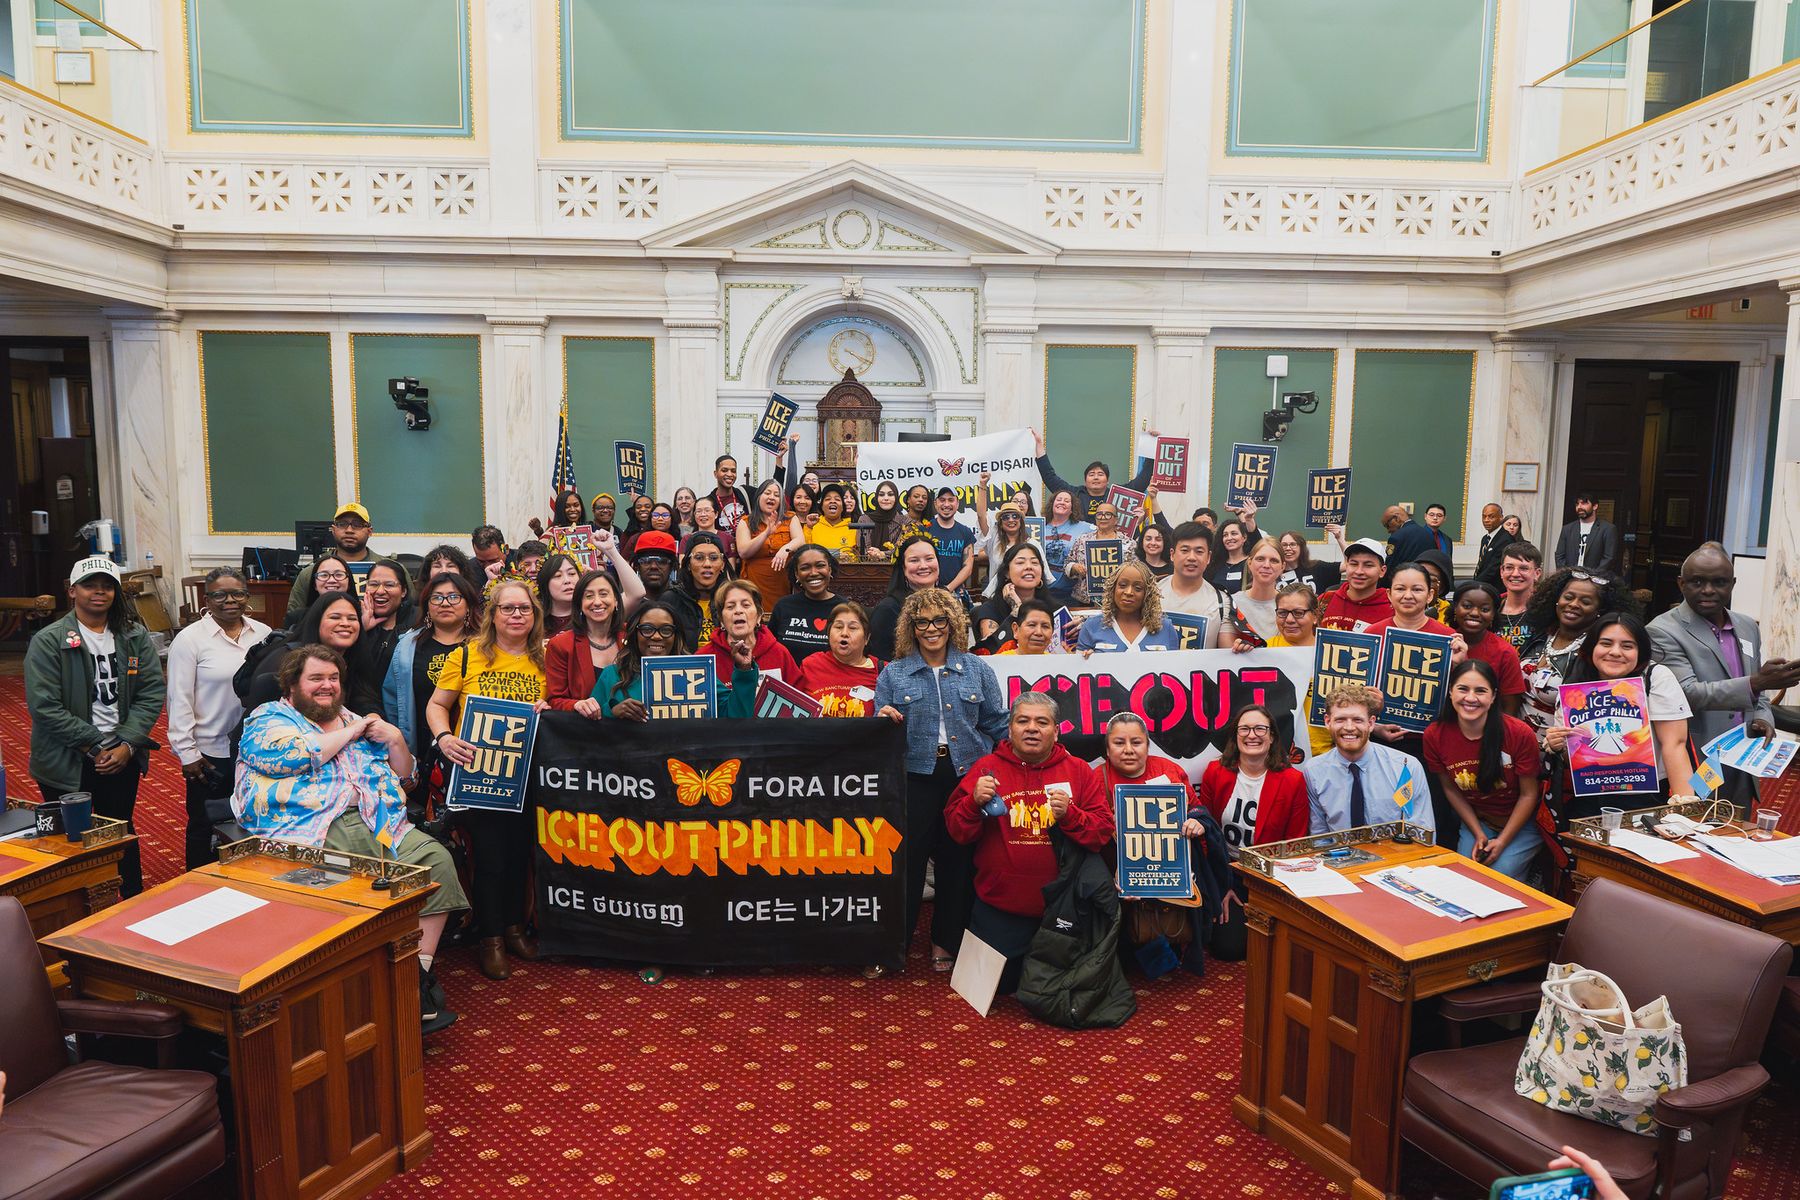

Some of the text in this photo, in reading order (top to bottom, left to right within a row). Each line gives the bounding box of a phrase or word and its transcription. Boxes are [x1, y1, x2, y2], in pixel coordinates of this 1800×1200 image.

[769, 400, 793, 424] ICE
[763, 416, 787, 438] OUT
[620, 447, 643, 465] ICE
[1160, 443, 1184, 461] ICE
[967, 456, 1033, 474] ICE DIŞARI
[1157, 461, 1183, 477] OUT
[1237, 452, 1271, 473] ICE
[620, 464, 645, 480] OUT
[859, 466, 934, 481] GLAS DEYO
[1234, 473, 1268, 491] OUT
[1313, 475, 1346, 494] ICE
[1111, 493, 1139, 513] ICE
[1311, 494, 1346, 511] OUT
[1117, 512, 1134, 528] UT
[562, 533, 588, 551] CE
[1089, 546, 1118, 563] ICE
[82, 559, 114, 572] PHILLY
[1090, 564, 1119, 578] OUT
[789, 617, 808, 628] PA
[785, 629, 829, 639] Immigrants
[1321, 642, 1370, 676] ICE
[1391, 642, 1442, 677] ICE
[477, 676, 541, 687] DOMESTIC
[481, 671, 537, 680] NATIONAL
[651, 668, 706, 702] ICE
[1386, 672, 1439, 704] OUT
[1589, 694, 1611, 709] ICE
[1385, 706, 1433, 721] PHILLY
[1569, 707, 1640, 725] OUT OF PHILLY
[470, 711, 527, 749] ICE
[463, 747, 522, 778] OUT
[482, 777, 497, 785] OF
[539, 765, 656, 800] ICE HORS
[748, 774, 879, 798] FORA ICE
[1584, 774, 1646, 785] 814-205-3293
[461, 783, 515, 797] PHILLY
[1124, 797, 1179, 829] ICE
[1231, 797, 1258, 827] IC
[536, 806, 893, 867] ICE OUT PHILLY
[1223, 823, 1256, 847] OU
[1124, 833, 1180, 862] OUT
[1128, 878, 1181, 887] PHILLY
[548, 885, 586, 911] ICE
[727, 896, 882, 922] ICE는 나가라
